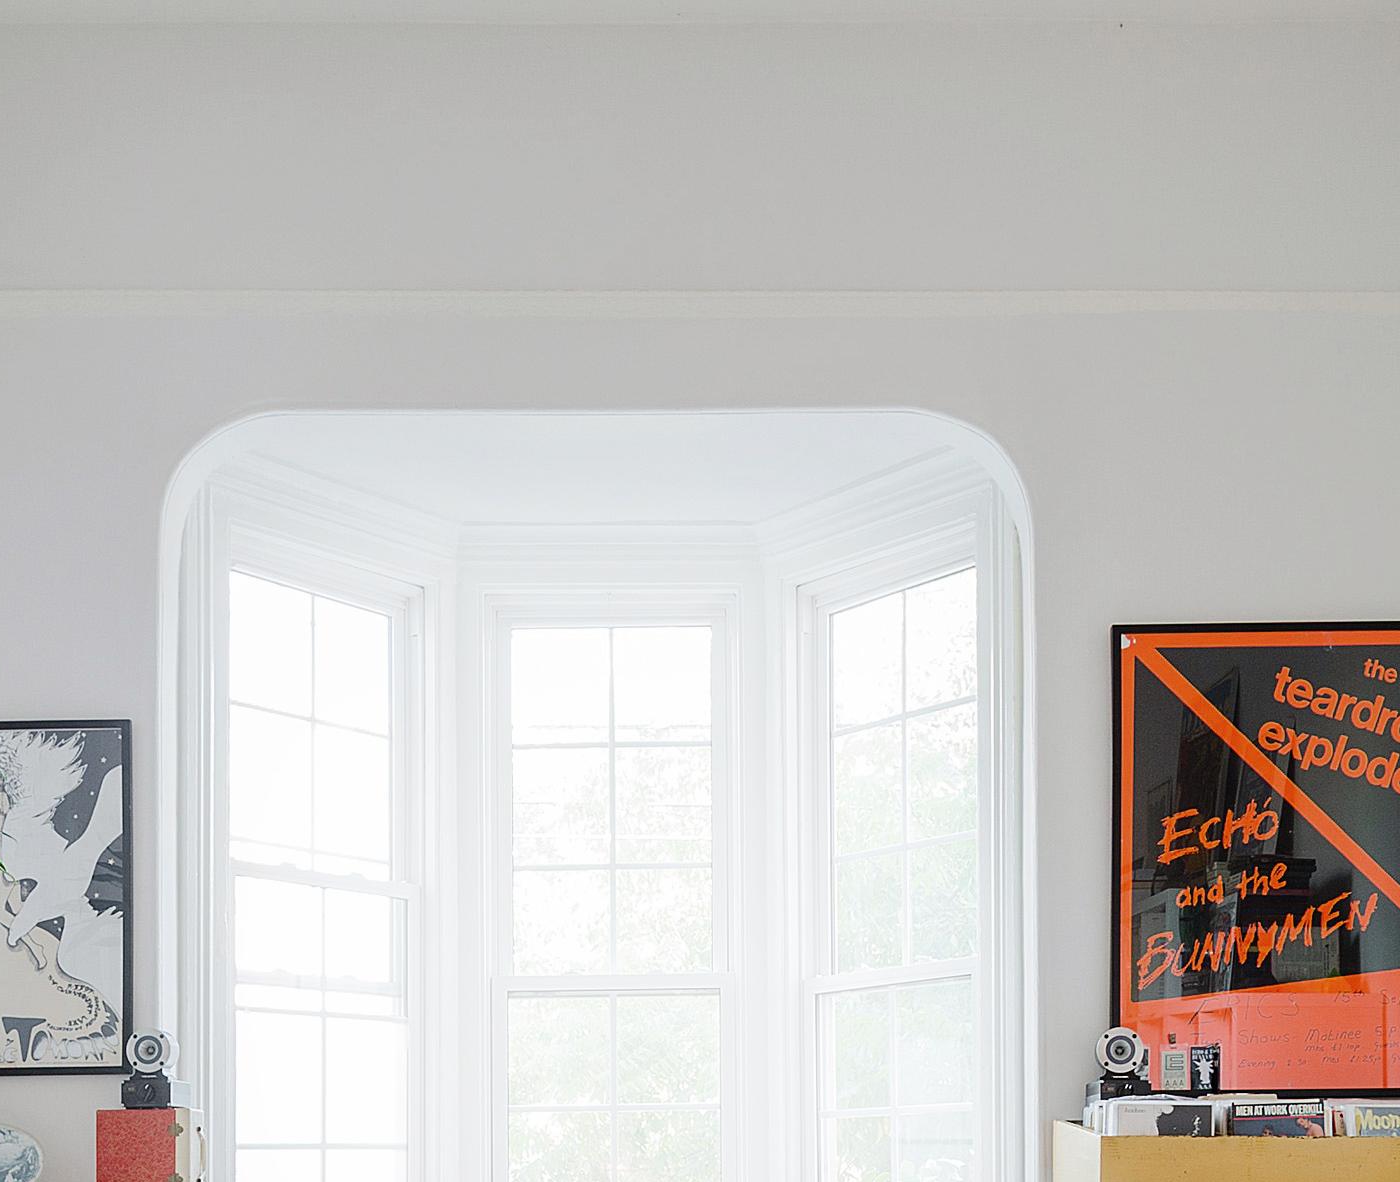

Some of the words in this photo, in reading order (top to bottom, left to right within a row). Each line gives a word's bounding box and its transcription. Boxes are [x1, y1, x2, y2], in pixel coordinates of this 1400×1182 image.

[1363, 658, 1398, 684] the
[1176, 874, 1224, 909] and
[1235, 862, 1288, 898] the
[1136, 890, 1379, 991] BUNNYMEN
[1235, 1104, 1253, 1117] MEN
[1253, 1105, 1264, 1116] AT
[1264, 1103, 1288, 1116] WORK
[1288, 1102, 1324, 1116] OVERKILL
